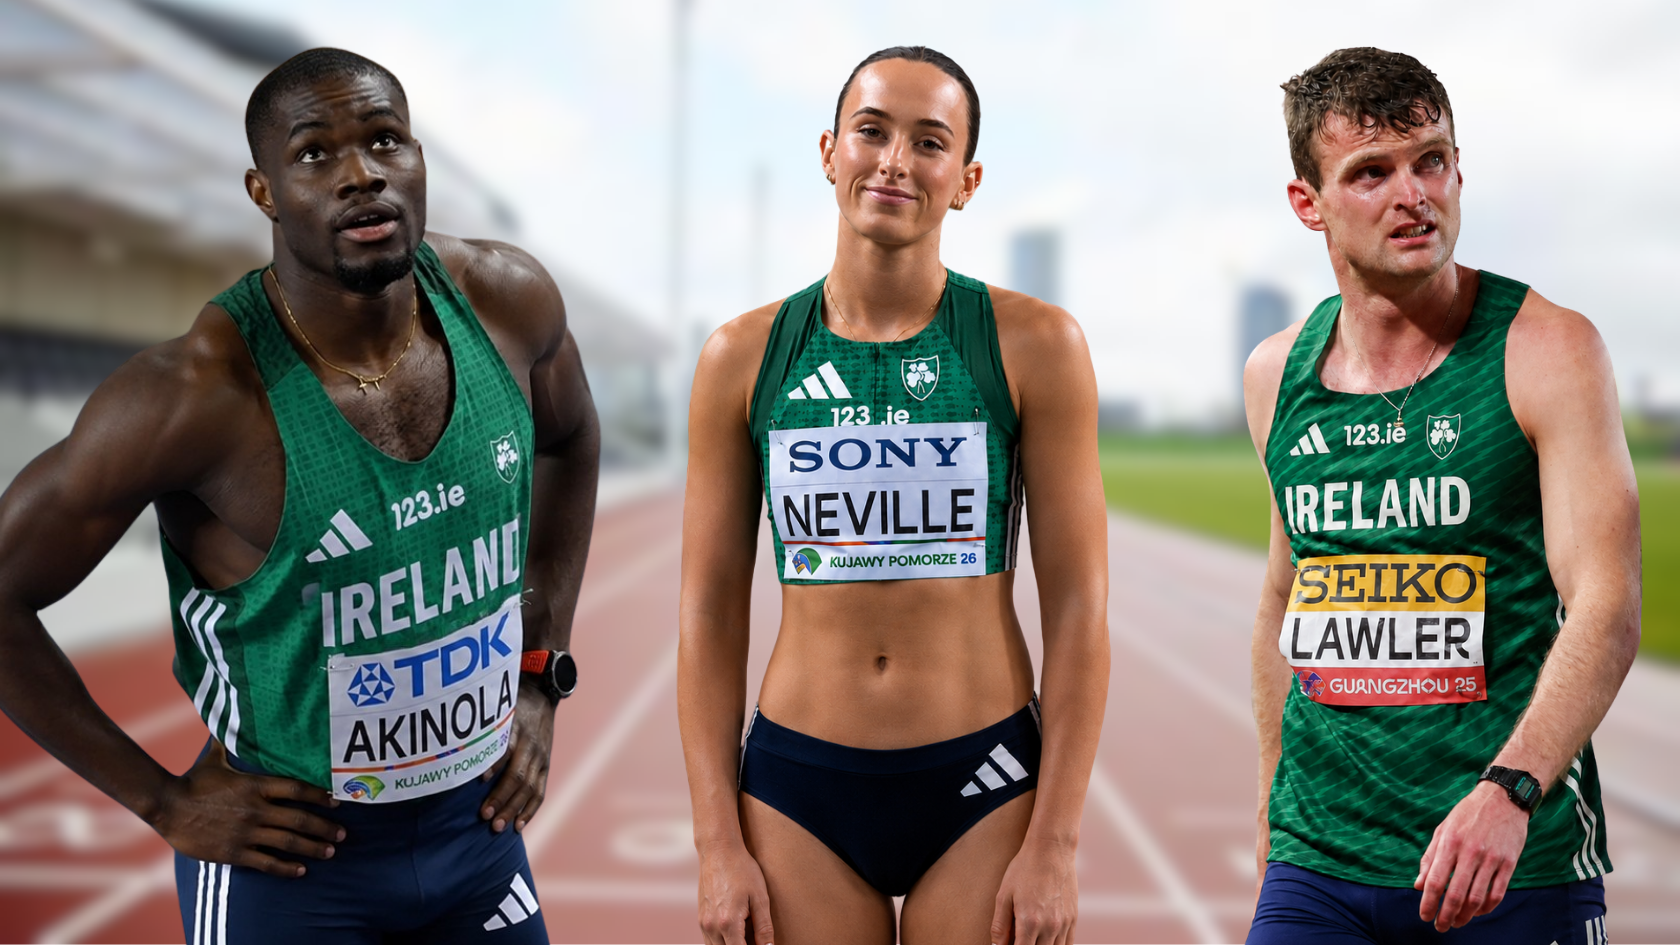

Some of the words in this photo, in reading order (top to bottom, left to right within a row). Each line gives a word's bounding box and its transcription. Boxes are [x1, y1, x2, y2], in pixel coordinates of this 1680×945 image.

[788, 437, 967, 473] SONY
[1343, 423, 1407, 446] 123.ie
[391, 483, 466, 531] 123.ie
[782, 488, 975, 537] NEVILLE
[1285, 476, 1471, 535] IRELAND
[320, 516, 521, 648] IRELAND
[829, 555, 885, 569] KUJAWY
[888, 553, 957, 567] POMORZE
[960, 552, 977, 565] 26
[1294, 562, 1477, 604] SEIKO
[393, 610, 513, 698] TDK
[1290, 617, 1471, 660] LAWLER
[1329, 677, 1449, 694] GUANGZHOU
[1454, 676, 1477, 693] 25
[342, 669, 513, 763] AKINOLA
[395, 766, 452, 790] KUJAWY
